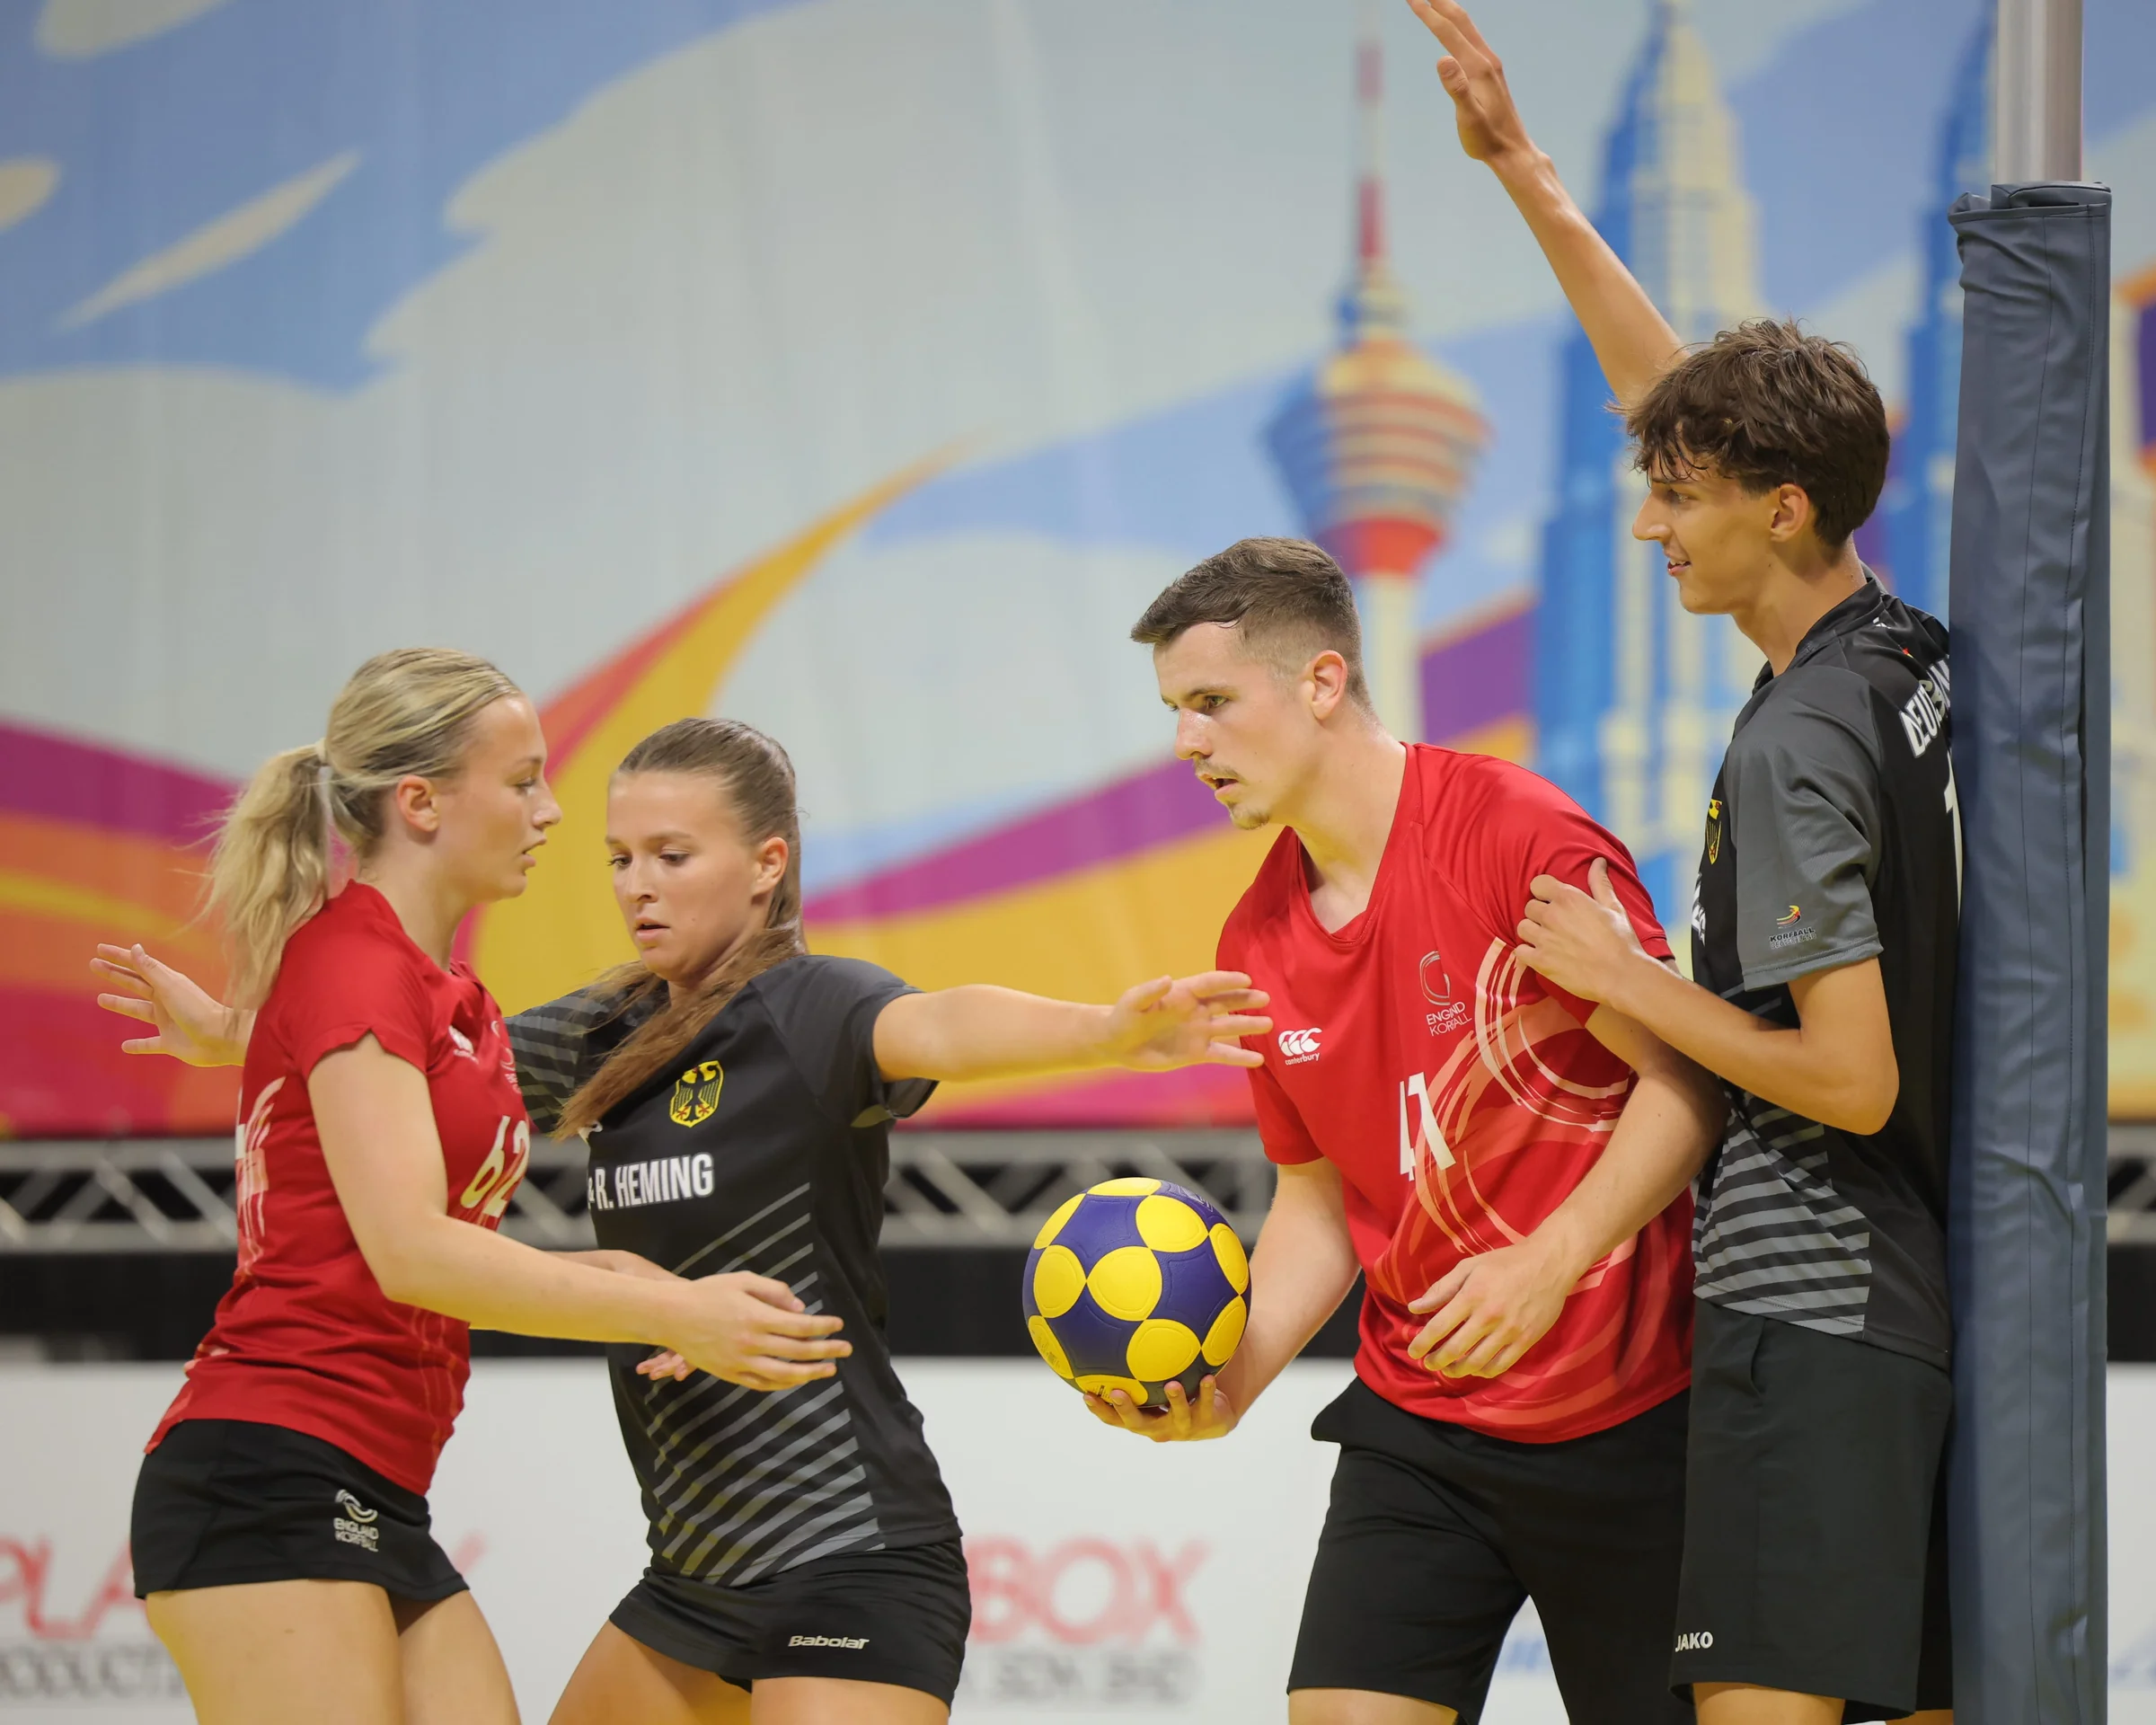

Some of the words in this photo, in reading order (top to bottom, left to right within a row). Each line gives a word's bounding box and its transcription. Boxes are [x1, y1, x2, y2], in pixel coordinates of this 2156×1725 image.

[1769, 927, 1816, 943] KORFBALL
[1285, 1052, 1321, 1066] canterbury
[460, 1115, 530, 1218] 62
[595, 1167, 614, 1210] R.
[614, 1153, 714, 1208] HEMING
[1674, 1631, 1714, 1652] JAKO
